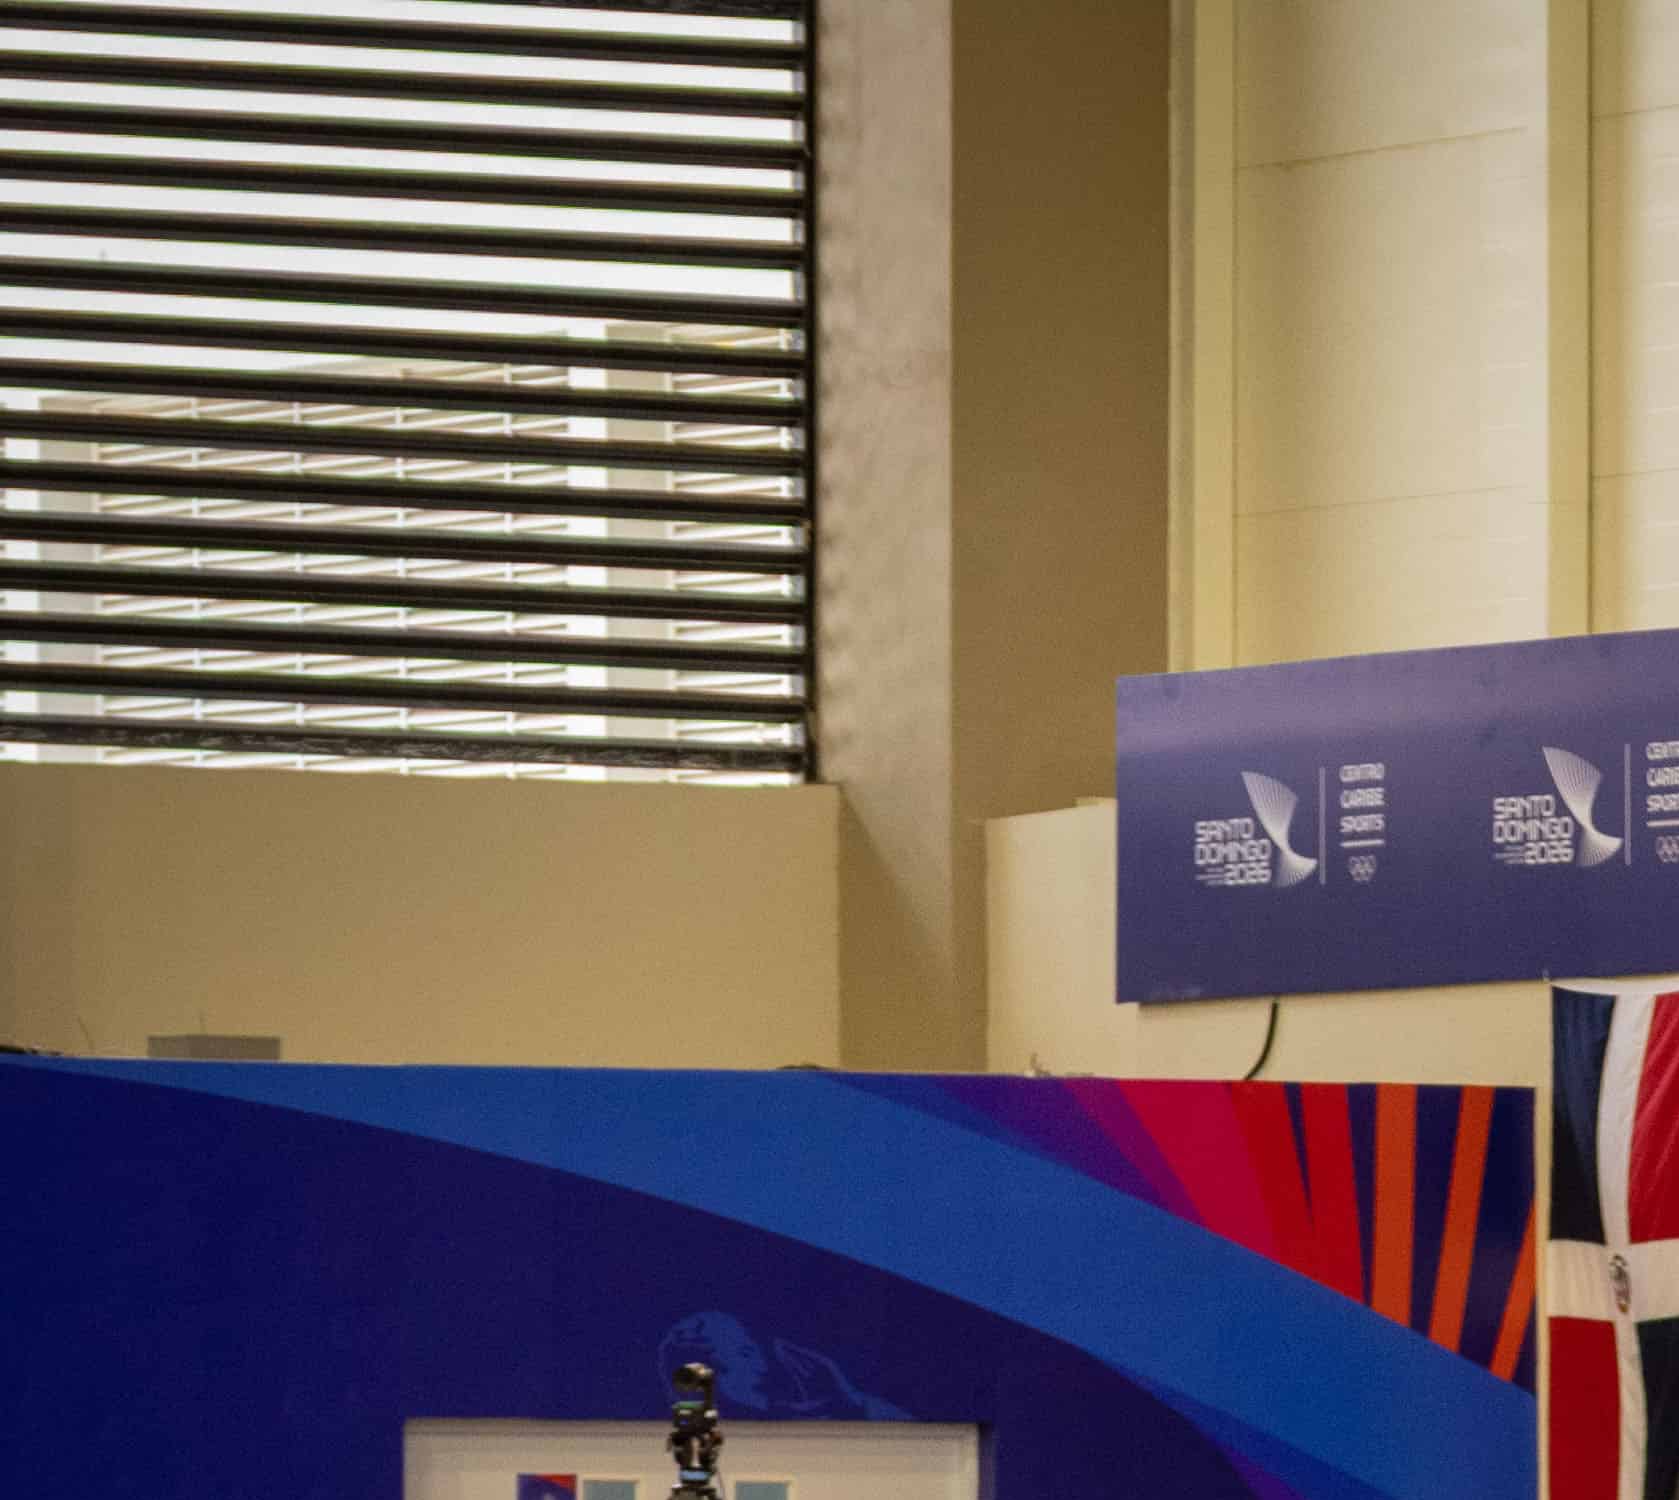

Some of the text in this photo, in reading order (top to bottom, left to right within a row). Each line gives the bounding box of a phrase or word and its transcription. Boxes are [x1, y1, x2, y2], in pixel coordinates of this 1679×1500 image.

[1493, 795, 1555, 820] SANTO
[1195, 817, 1254, 842] SANTO
[1493, 816, 1574, 843] DOMINGO
[1194, 838, 1272, 865] DOMINGO
[1524, 840, 1574, 864] 2026
[1224, 862, 1272, 885] 2026
